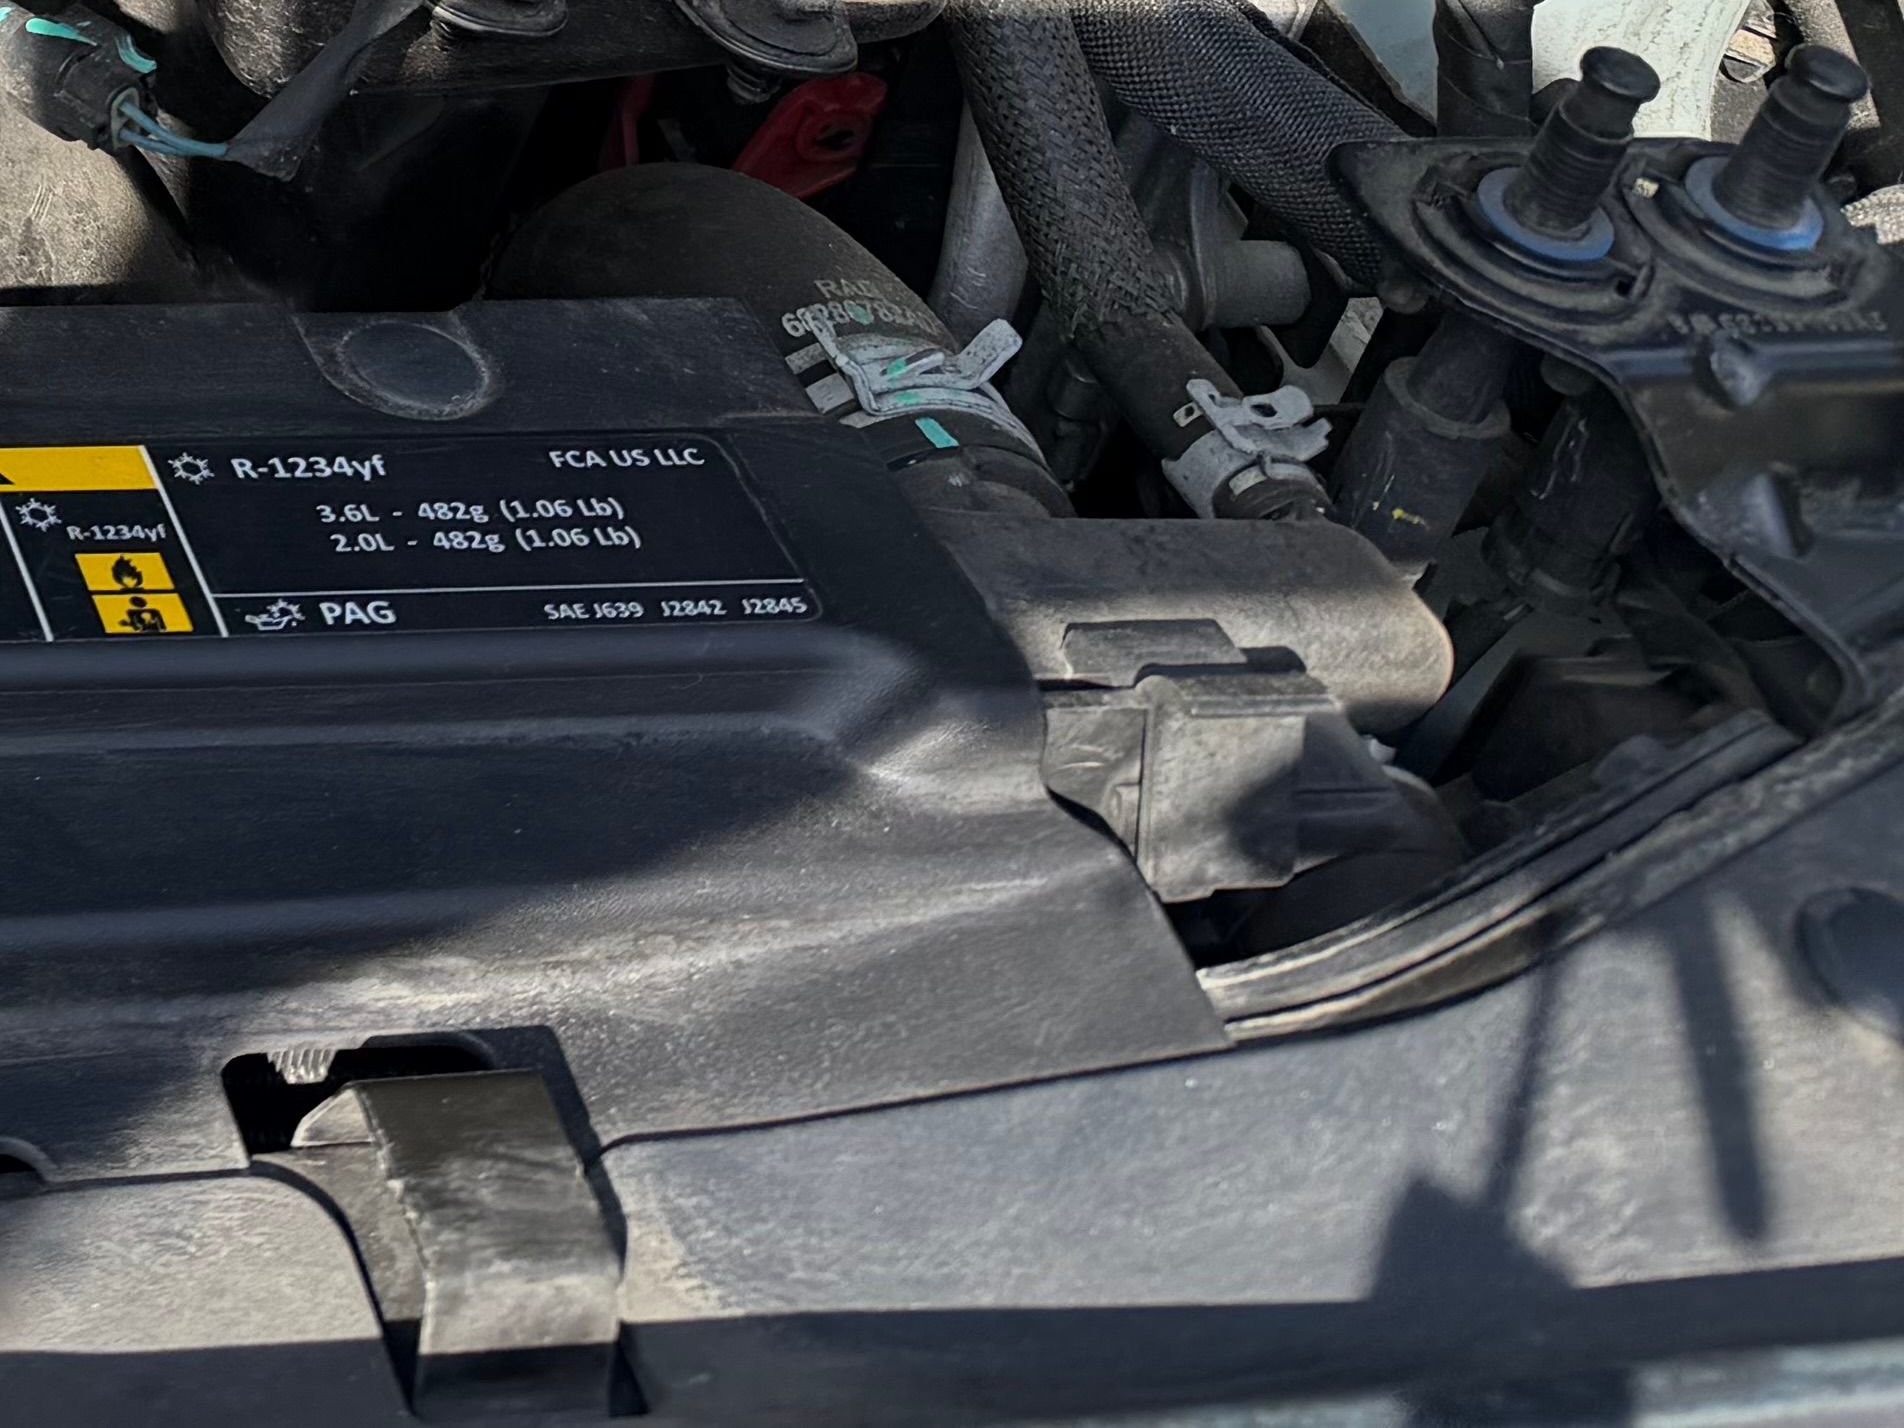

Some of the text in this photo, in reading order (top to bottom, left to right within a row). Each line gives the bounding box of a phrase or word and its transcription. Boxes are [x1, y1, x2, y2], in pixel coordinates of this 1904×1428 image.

[231, 454, 387, 482] R-1234yf
[548, 448, 706, 468] FCA US LLC
[315, 503, 380, 523] 3.6L
[417, 500, 490, 524] 482g
[500, 498, 573, 523] (1.06
[576, 496, 626, 521] Lb)
[66, 523, 168, 542] R-1234yf
[330, 532, 395, 553] 2.0L
[433, 530, 506, 553] 482g
[515, 529, 590, 552] (1.06
[593, 526, 642, 550] Lb)
[318, 600, 398, 626] PAG
[543, 597, 808, 620] SAE J639 J2842 J2845
